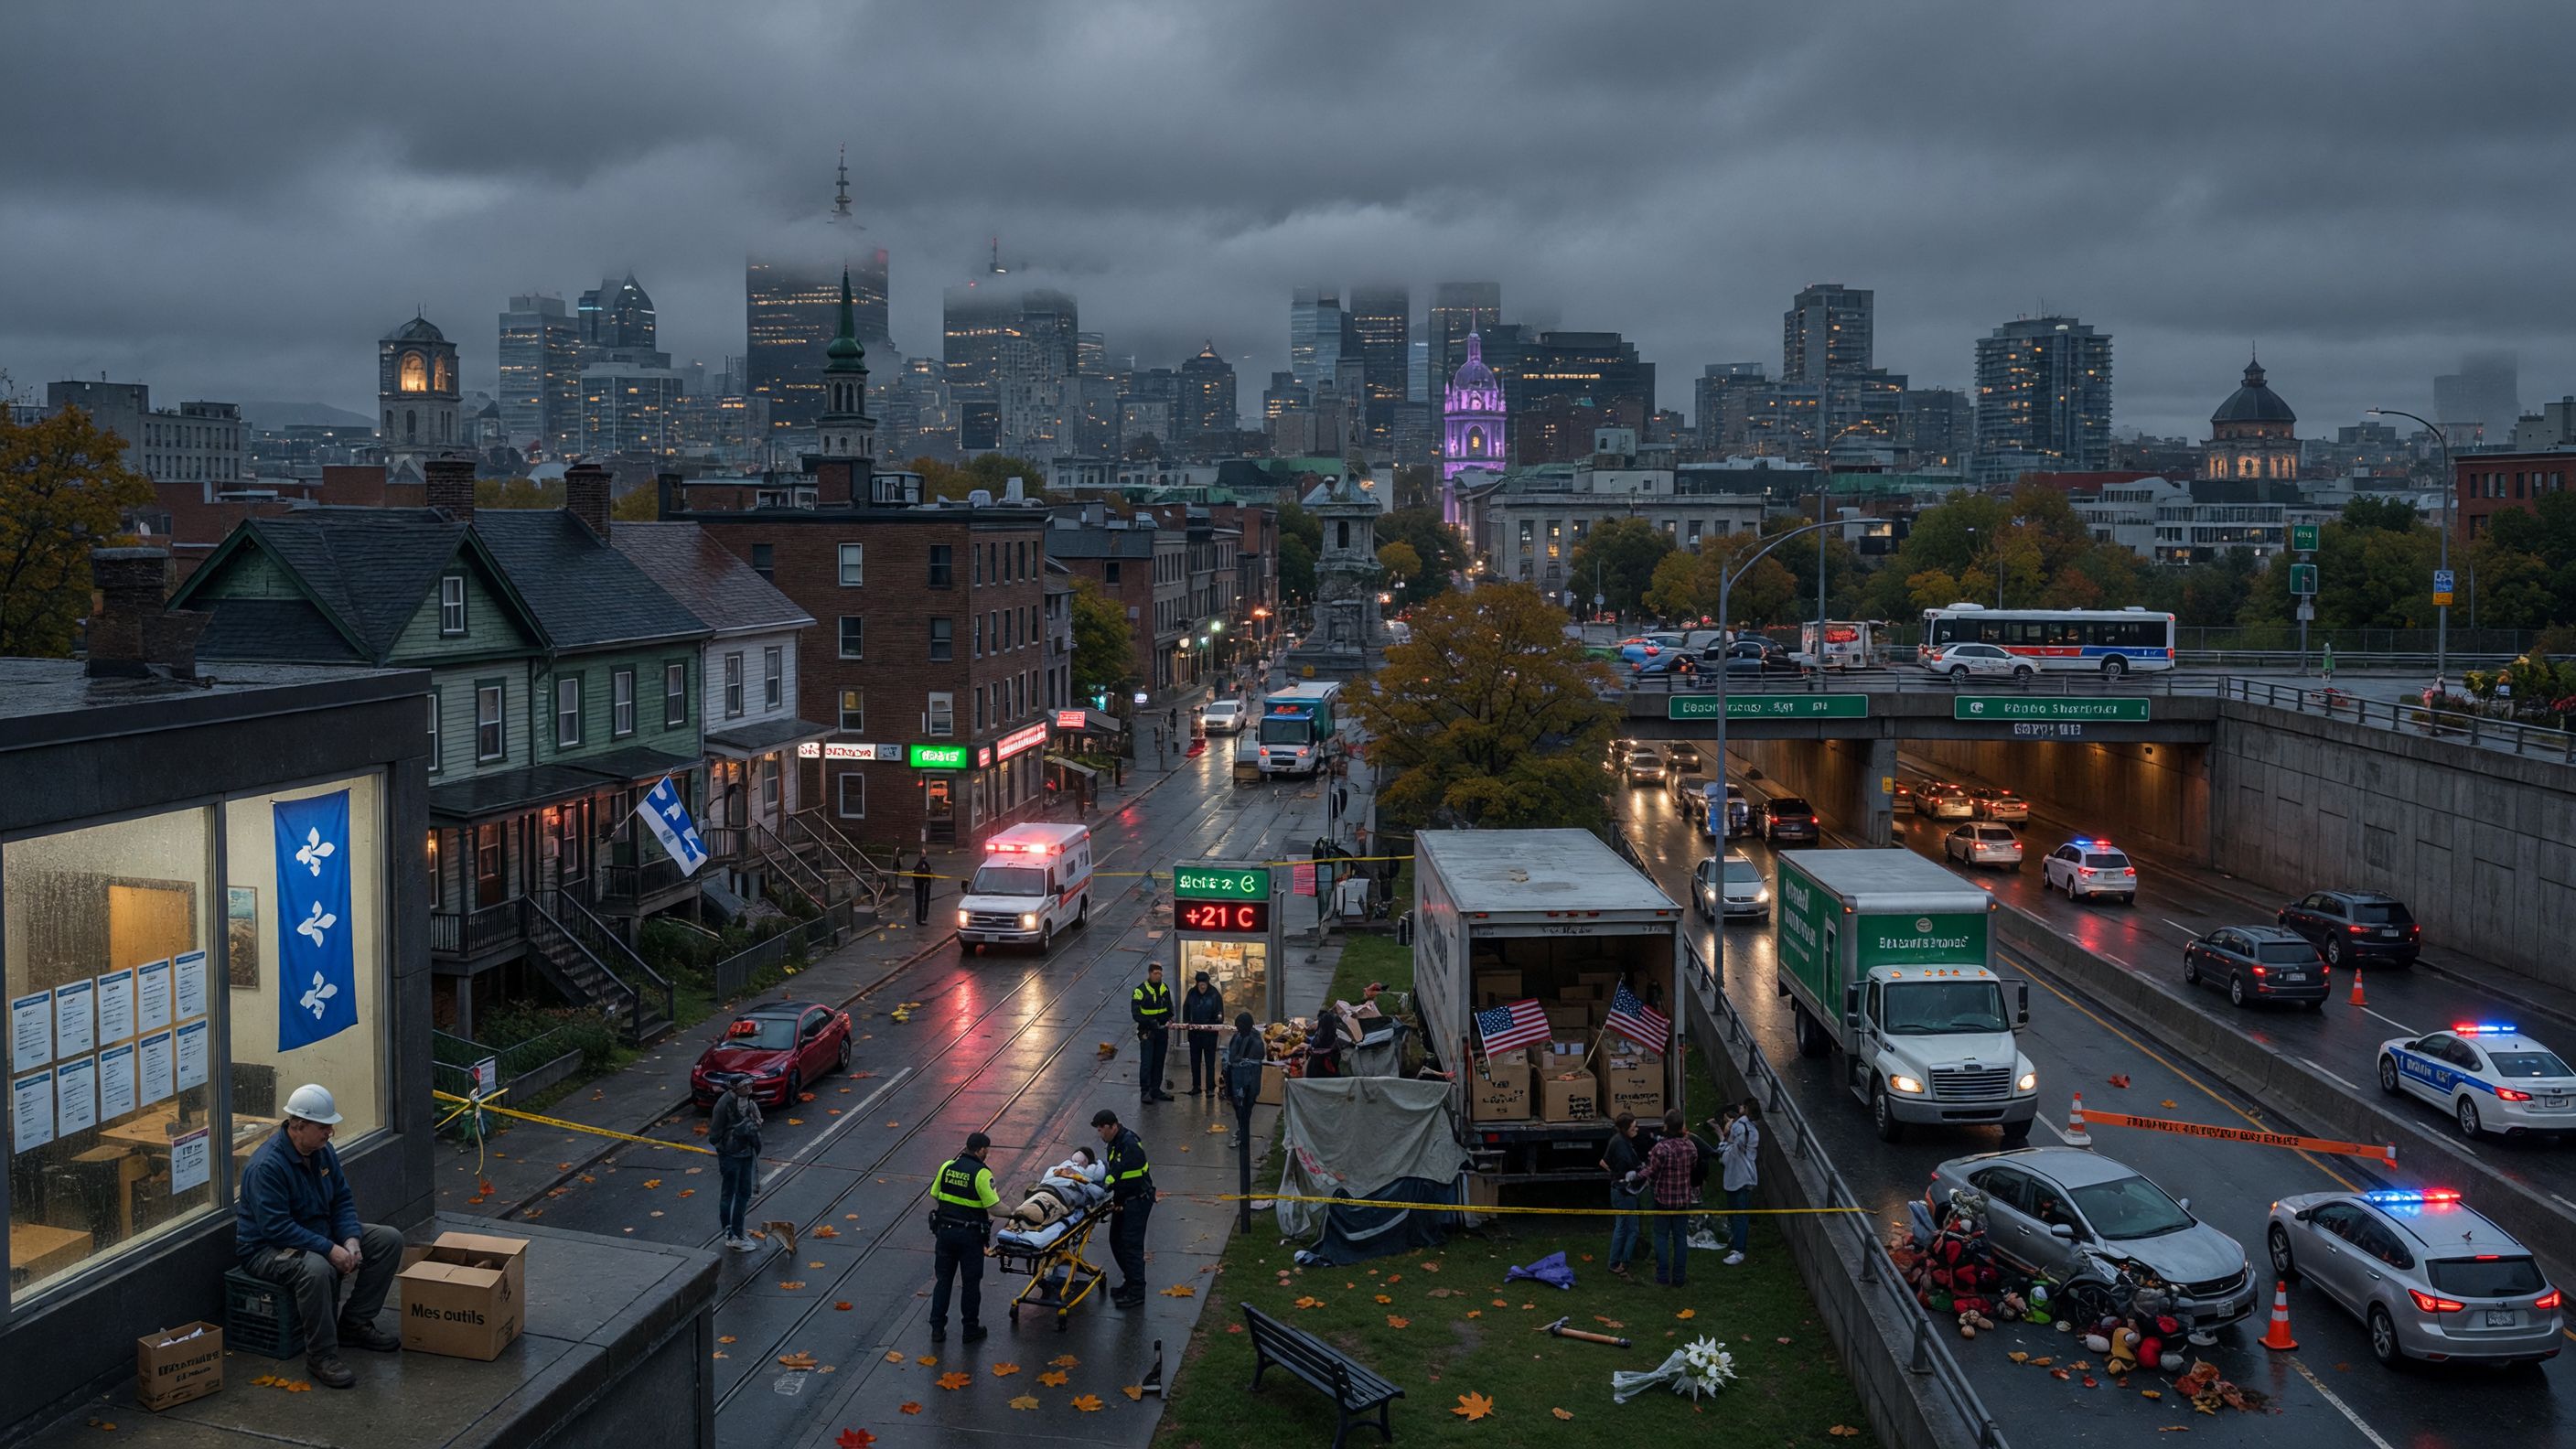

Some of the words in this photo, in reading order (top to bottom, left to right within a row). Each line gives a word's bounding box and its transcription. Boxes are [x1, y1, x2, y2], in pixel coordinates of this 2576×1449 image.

[1186, 906, 1227, 928] +21
[1237, 907, 1254, 928] C
[411, 1303, 441, 1320] Mes
[444, 1309, 486, 1326] outils
